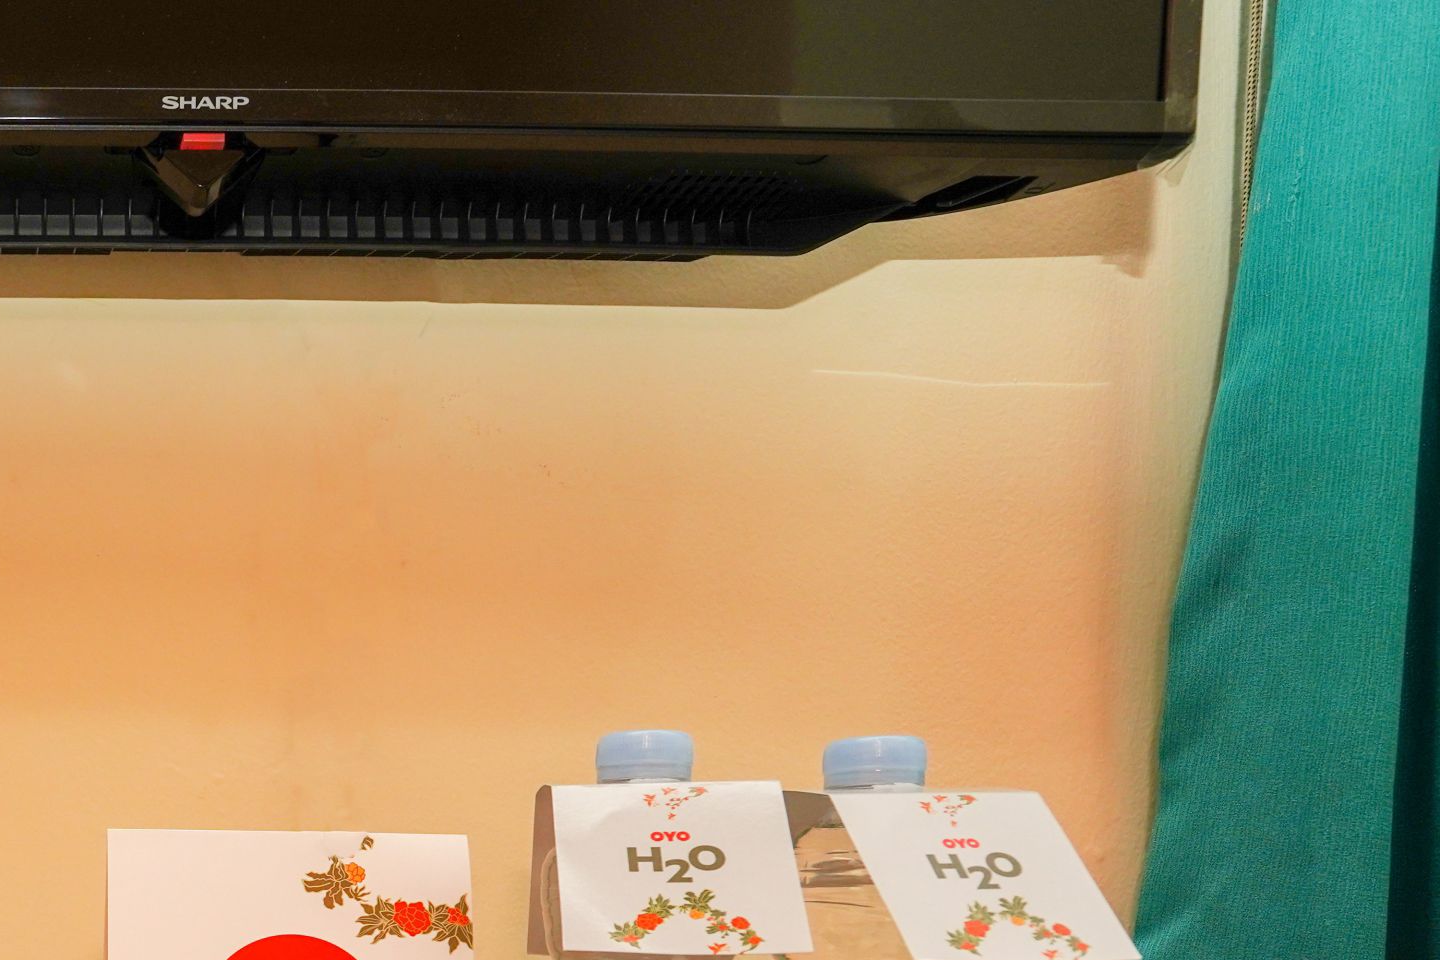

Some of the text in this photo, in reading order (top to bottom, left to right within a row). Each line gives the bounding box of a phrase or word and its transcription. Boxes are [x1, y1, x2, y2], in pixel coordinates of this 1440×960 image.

[161, 96, 250, 110] SHARP
[650, 831, 691, 842] OYO
[942, 838, 980, 849] OYO
[626, 844, 726, 884] H2O
[925, 851, 1023, 890] H2O
